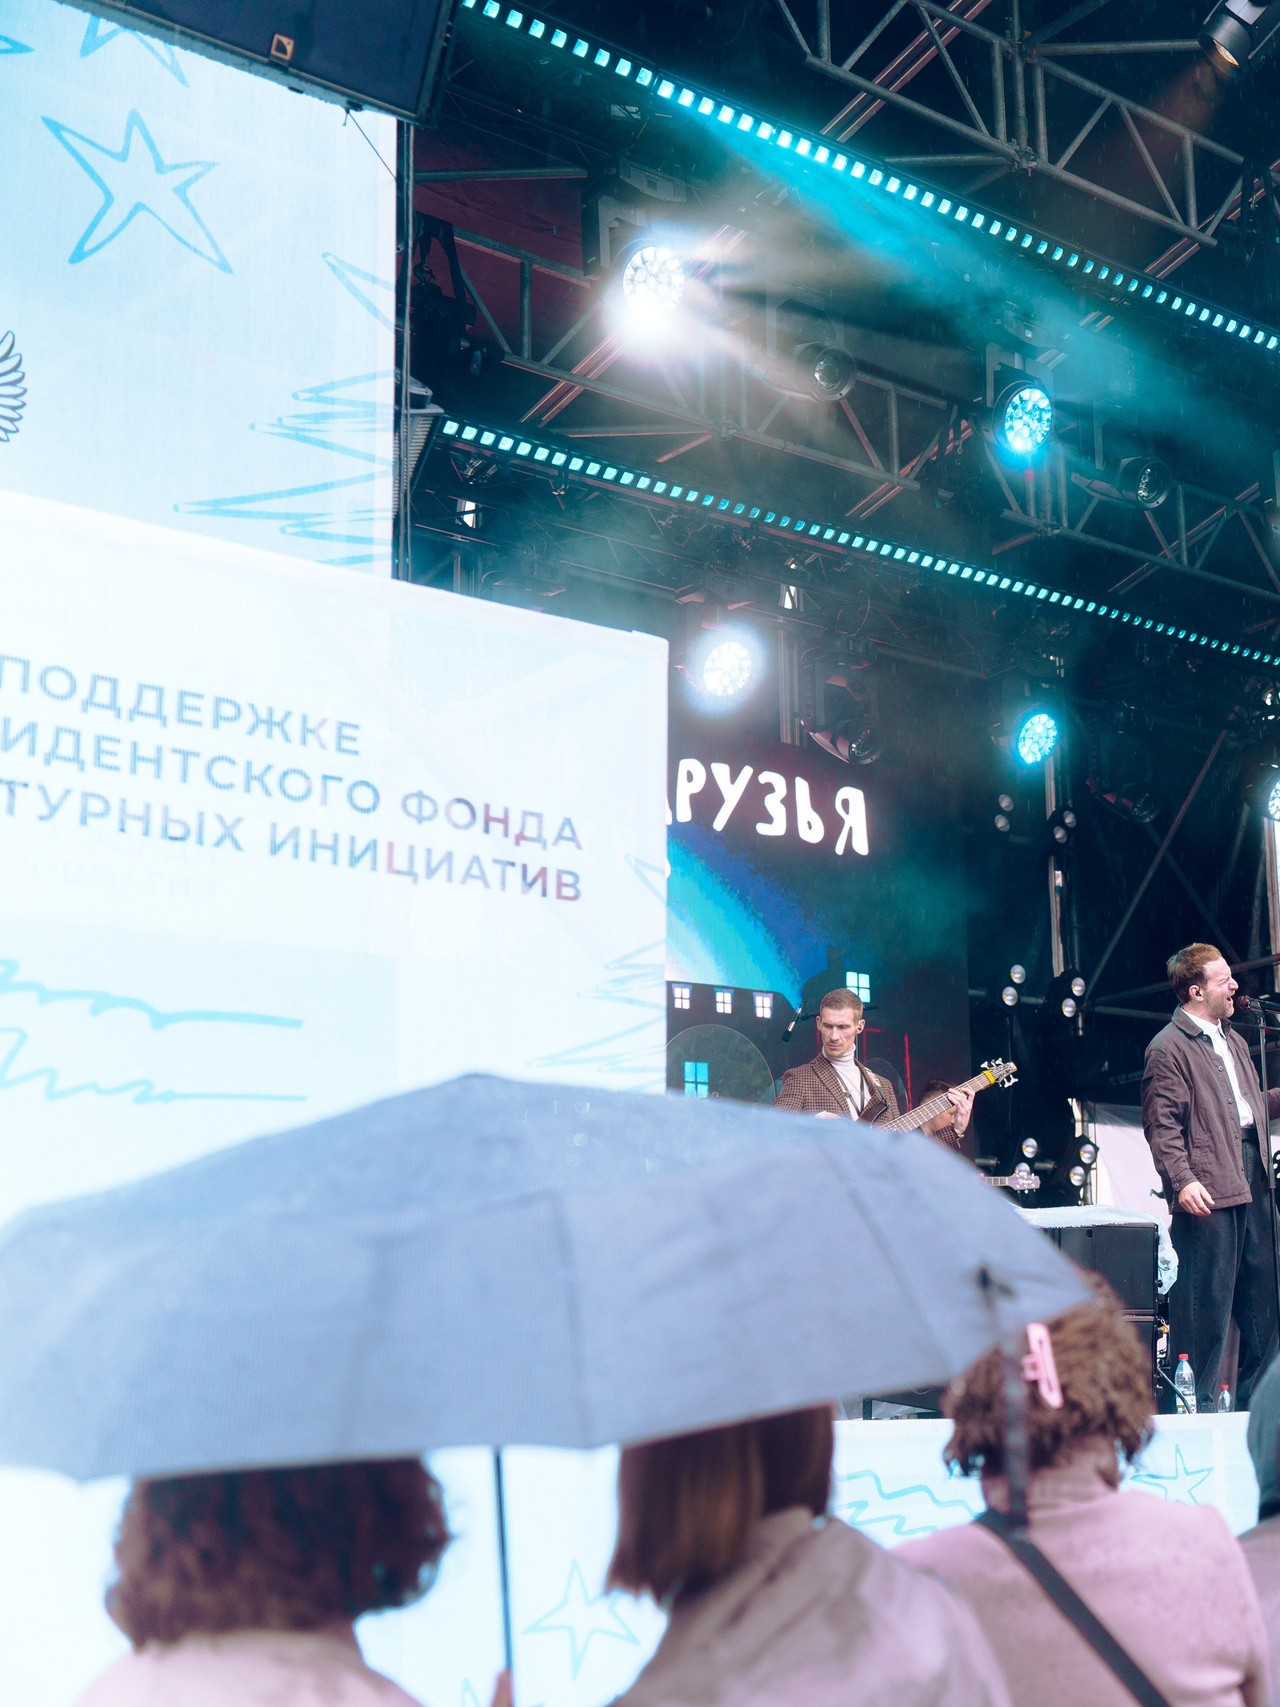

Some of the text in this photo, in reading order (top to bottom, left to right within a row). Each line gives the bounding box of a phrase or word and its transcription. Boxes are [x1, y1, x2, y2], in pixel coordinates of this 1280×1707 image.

[0, 653, 361, 756] ПОДДЕРЖКЕ
[401, 789, 584, 850] ФОНДА
[665, 758, 869, 856] РУЗЬЯ
[269, 821, 582, 901] ИНИЦИАТИВ
